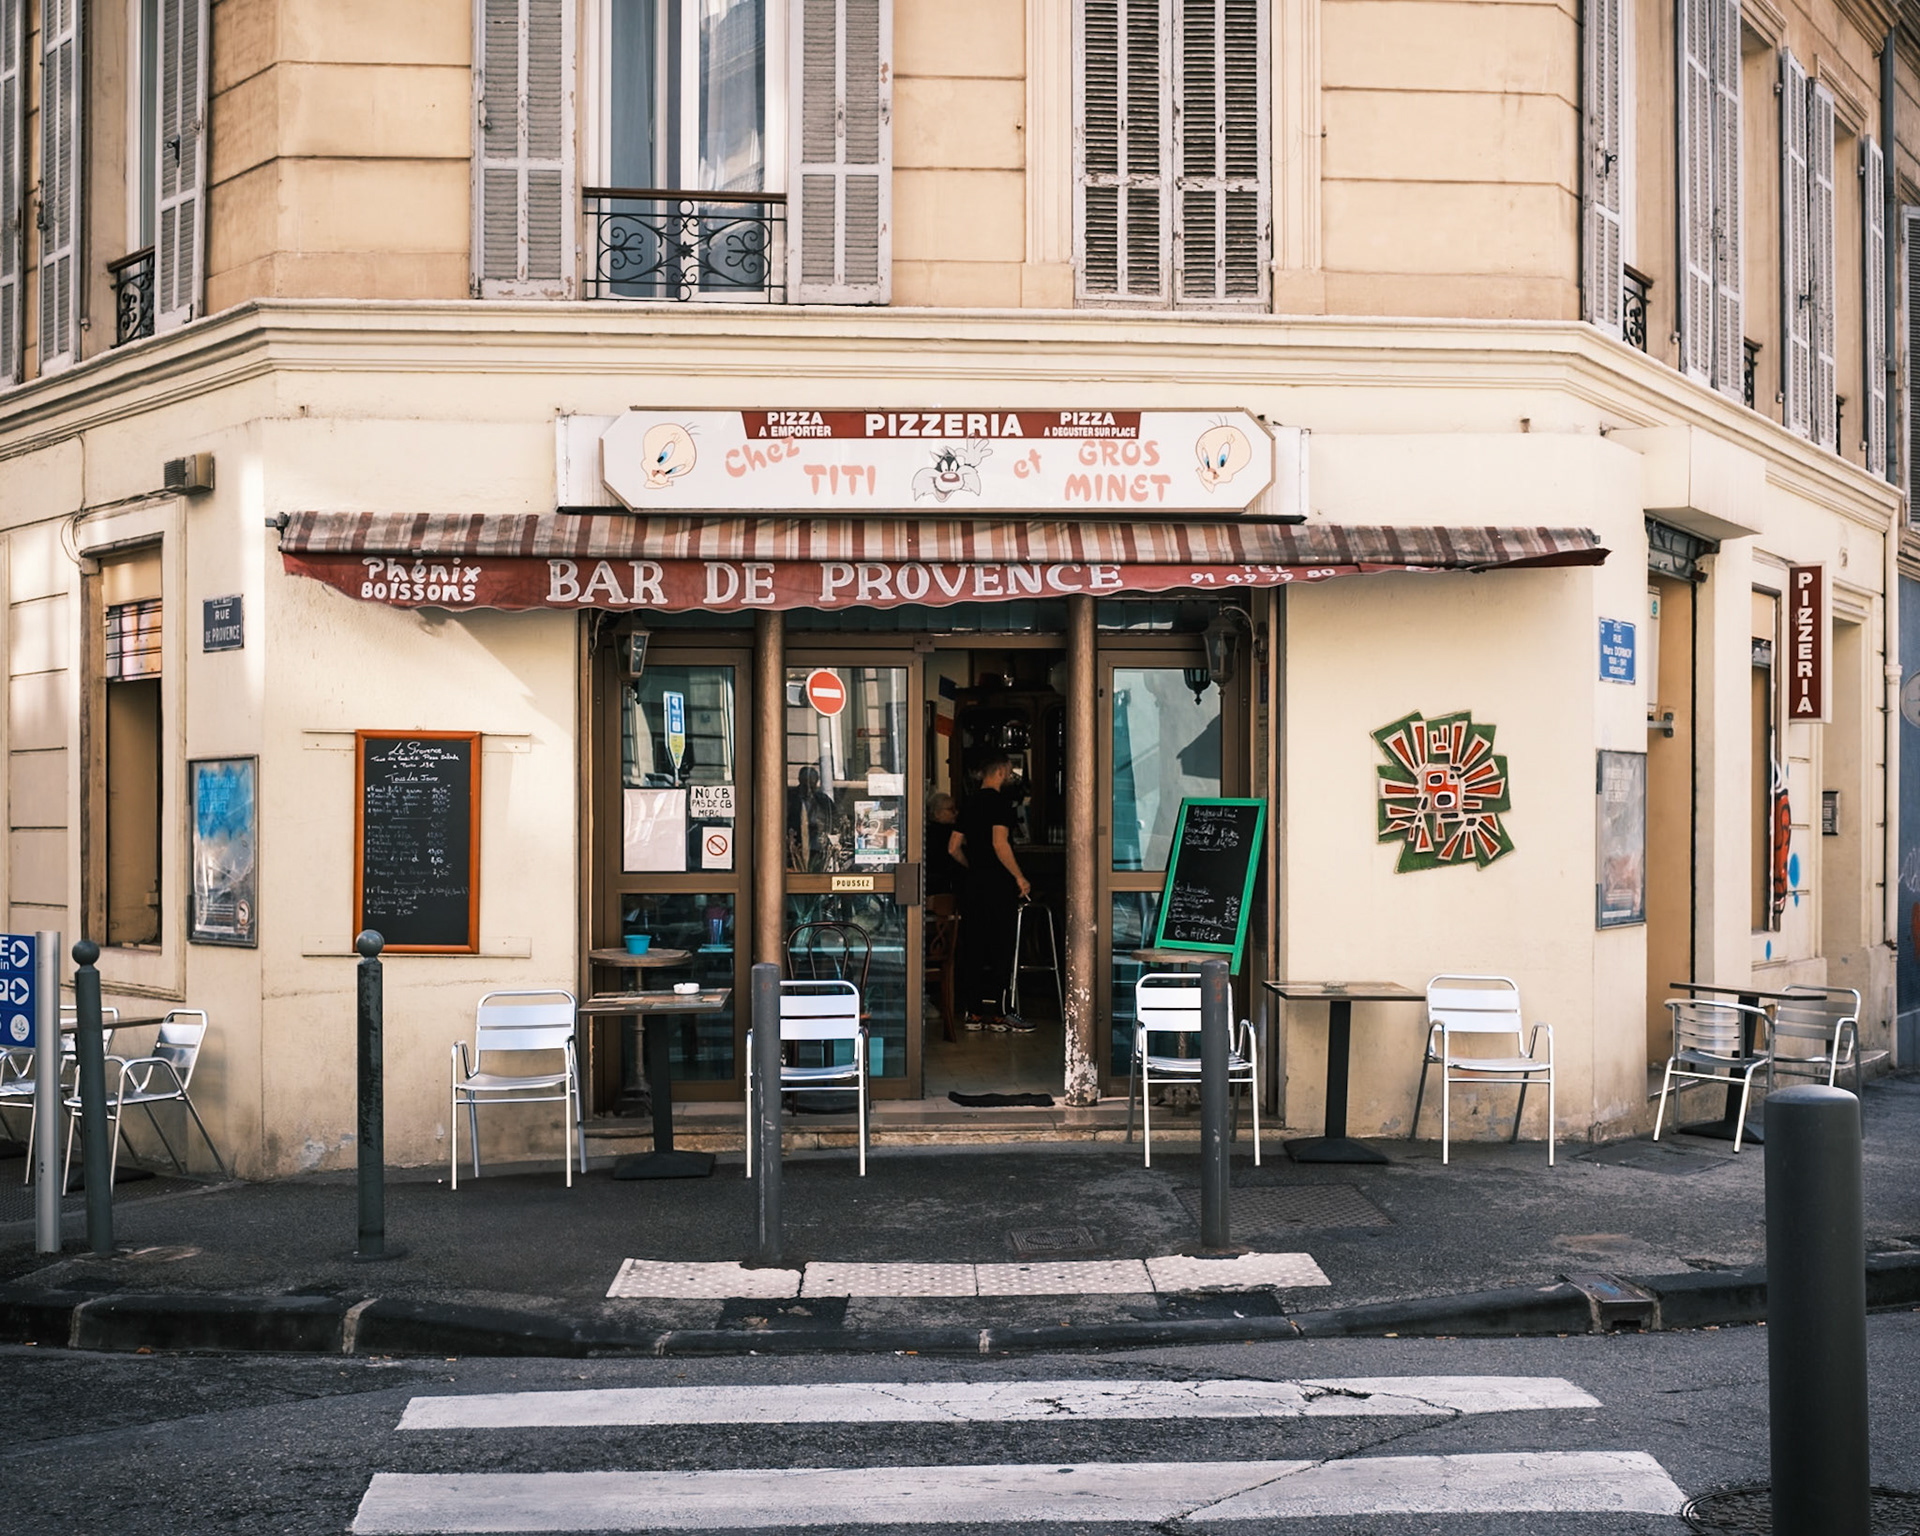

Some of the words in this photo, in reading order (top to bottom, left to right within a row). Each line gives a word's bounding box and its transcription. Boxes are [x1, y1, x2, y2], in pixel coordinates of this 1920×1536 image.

[767, 412, 824, 425] PIZZA
[865, 413, 1024, 437] PIZZERIA
[1060, 412, 1116, 426] PIZZA
[758, 427, 767, 437] A
[771, 426, 832, 437] EMPORTER
[1044, 427, 1050, 437] A
[1052, 427, 1094, 437] DEGUSTER
[1094, 427, 1110, 437] SUR
[1112, 427, 1136, 437] PLACE
[725, 436, 800, 478] Chez
[803, 465, 876, 496] TITI
[1013, 449, 1042, 479] et
[1078, 440, 1160, 466] GROS
[1064, 474, 1172, 502] MINET
[362, 557, 482, 583] Phénix
[1190, 572, 1215, 584] 91
[1226, 573, 1258, 584] 49
[1267, 573, 1294, 583] 79
[1307, 568, 1336, 579] 80
[546, 560, 668, 604] BAR
[703, 562, 775, 605] DE
[818, 561, 1123, 601] PROVENCE
[214, 608, 230, 620] RUE
[212, 625, 240, 642] PROVENCE
[1796, 572, 1813, 713] PIZZERIA
[388, 742, 405, 755] Le
[696, 788, 710, 798] NO
[714, 788, 730, 798] CB
[692, 800, 706, 808] PAS
[707, 800, 718, 808] DE
[720, 800, 732, 808] CB
